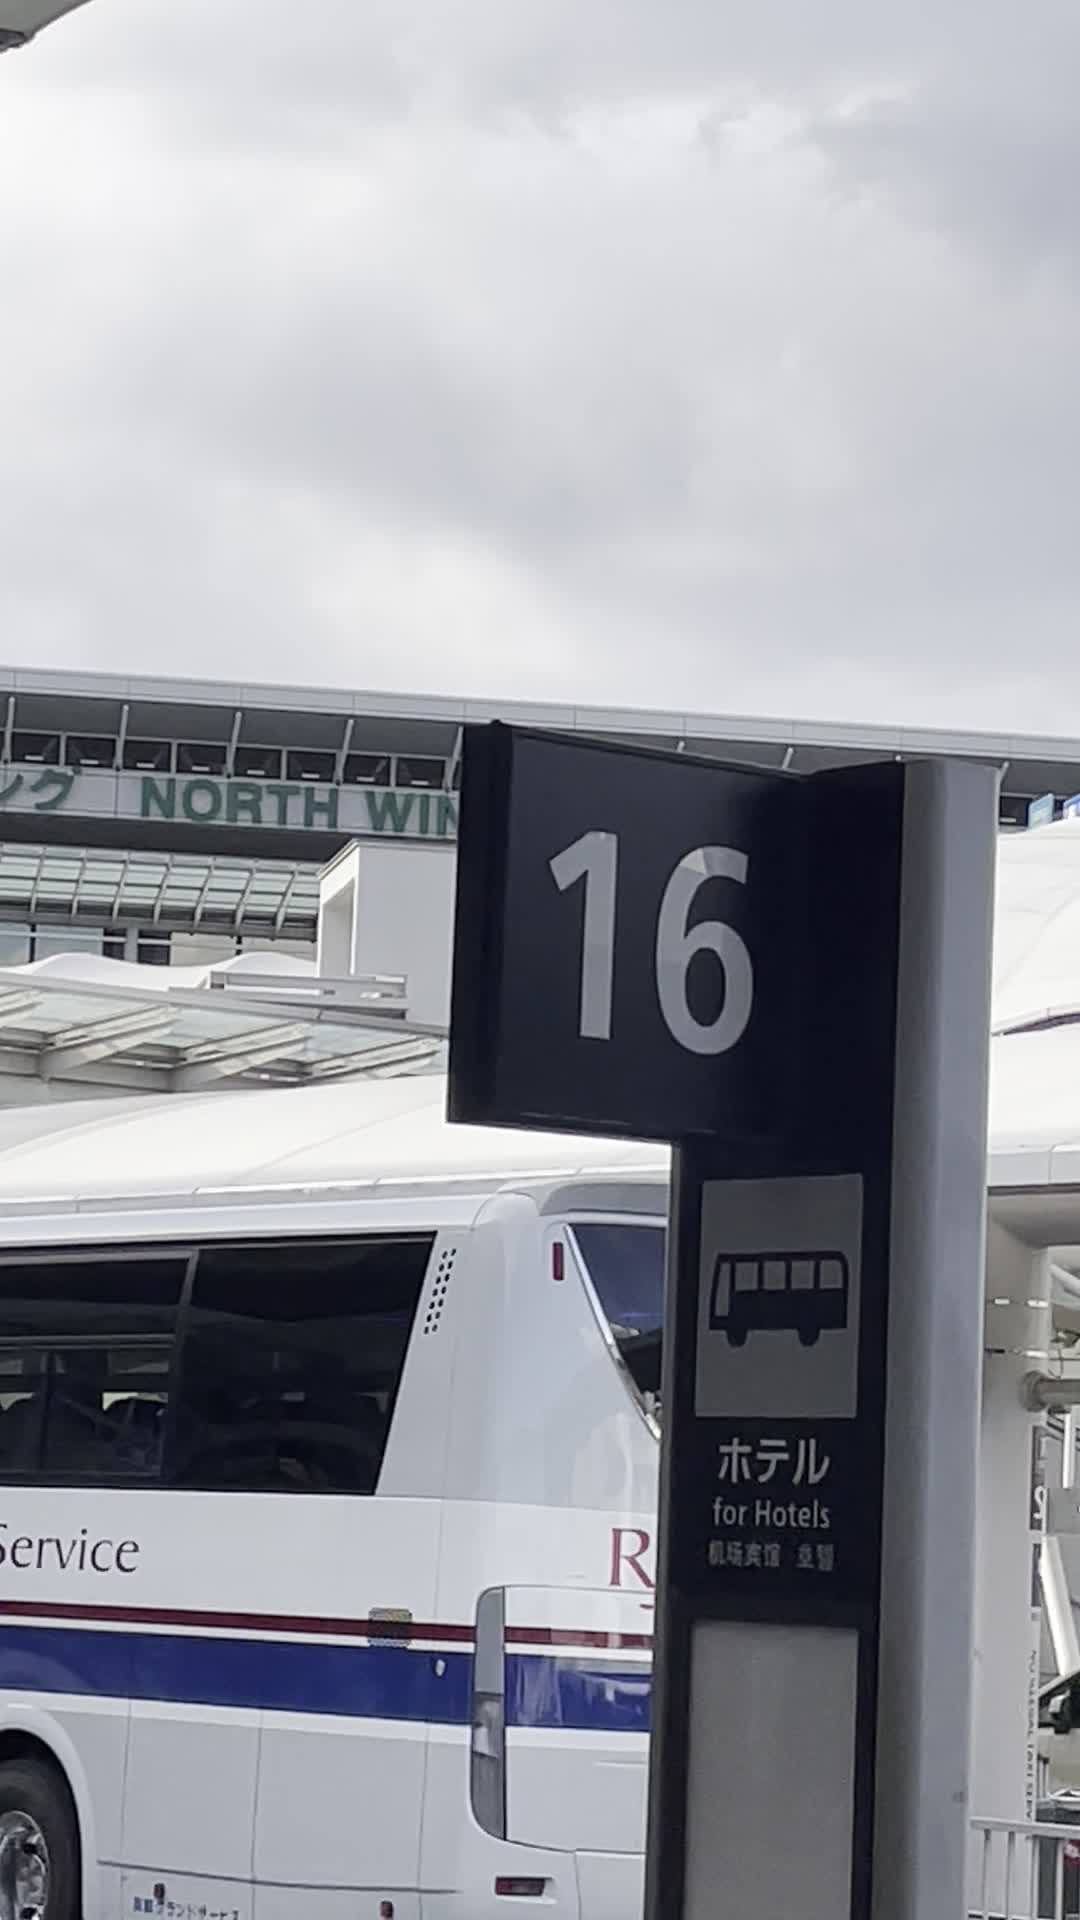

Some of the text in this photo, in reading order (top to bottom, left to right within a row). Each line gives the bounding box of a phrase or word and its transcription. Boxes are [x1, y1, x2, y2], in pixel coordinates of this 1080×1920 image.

[141, 776, 339, 829] NORTH
[549, 830, 753, 1056] 16
[718, 1437, 830, 1485] ホテル
[713, 1496, 831, 1528] for Hotels
